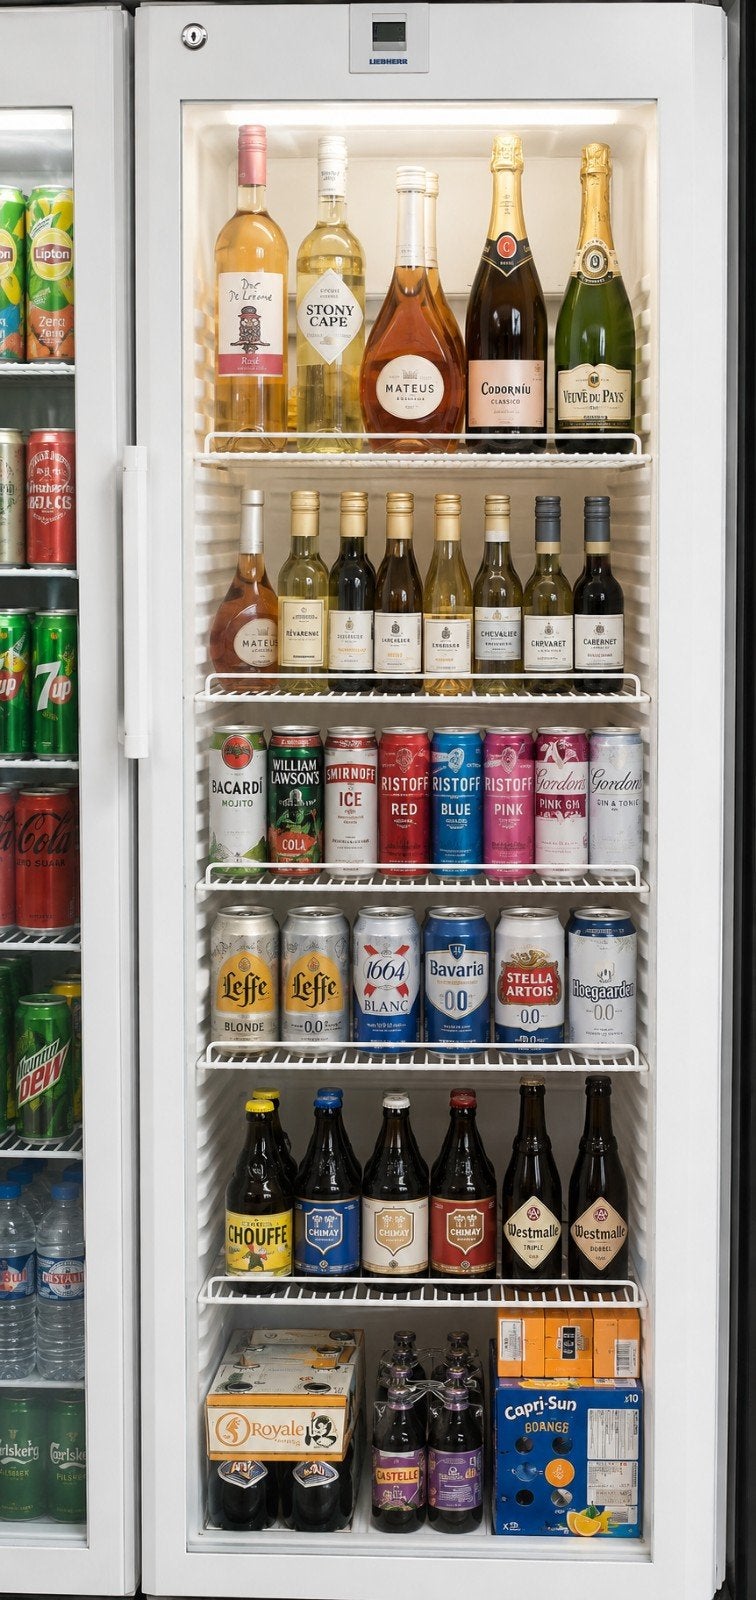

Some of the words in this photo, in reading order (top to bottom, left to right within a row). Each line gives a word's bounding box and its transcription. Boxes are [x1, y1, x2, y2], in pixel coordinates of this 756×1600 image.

[35, 247, 70, 263] Lipton
[306, 304, 354, 316] STONY
[309, 316, 348, 328] CAPE
[385, 384, 435, 394] MATEUS
[272, 758, 316, 771] WILLIAM
[271, 771, 320, 786] LAWSON'S
[326, 767, 376, 782] SMIRNOFF
[432, 776, 480, 792] RISTOFF
[485, 776, 532, 792] RISTOFF
[221, 799, 254, 808] MOJITO
[339, 791, 362, 807] ICE
[539, 799, 562, 810] PINK
[391, 802, 418, 815] RED
[441, 803, 471, 816] BLUE
[494, 803, 523, 815] PINK
[282, 839, 306, 852] COLA
[367, 960, 406, 981] 1664
[430, 959, 485, 978] Bavaria
[506, 971, 553, 985] STELLA
[221, 971, 270, 1008] Leffe
[291, 971, 339, 1009] Leffe
[506, 985, 554, 998] ARTOIS
[364, 999, 408, 1013] BLANC
[224, 1021, 264, 1033] BLONDE
[228, 1224, 287, 1246] CHOUFFE
[450, 1227, 481, 1237] CHIMAY
[507, 1222, 559, 1239] Westmalle
[574, 1224, 626, 1240] Westmalle
[504, 1396, 577, 1420] Capri-Sun
[251, 1420, 304, 1440] Royale
[377, 1470, 419, 1481] CASTELLE
